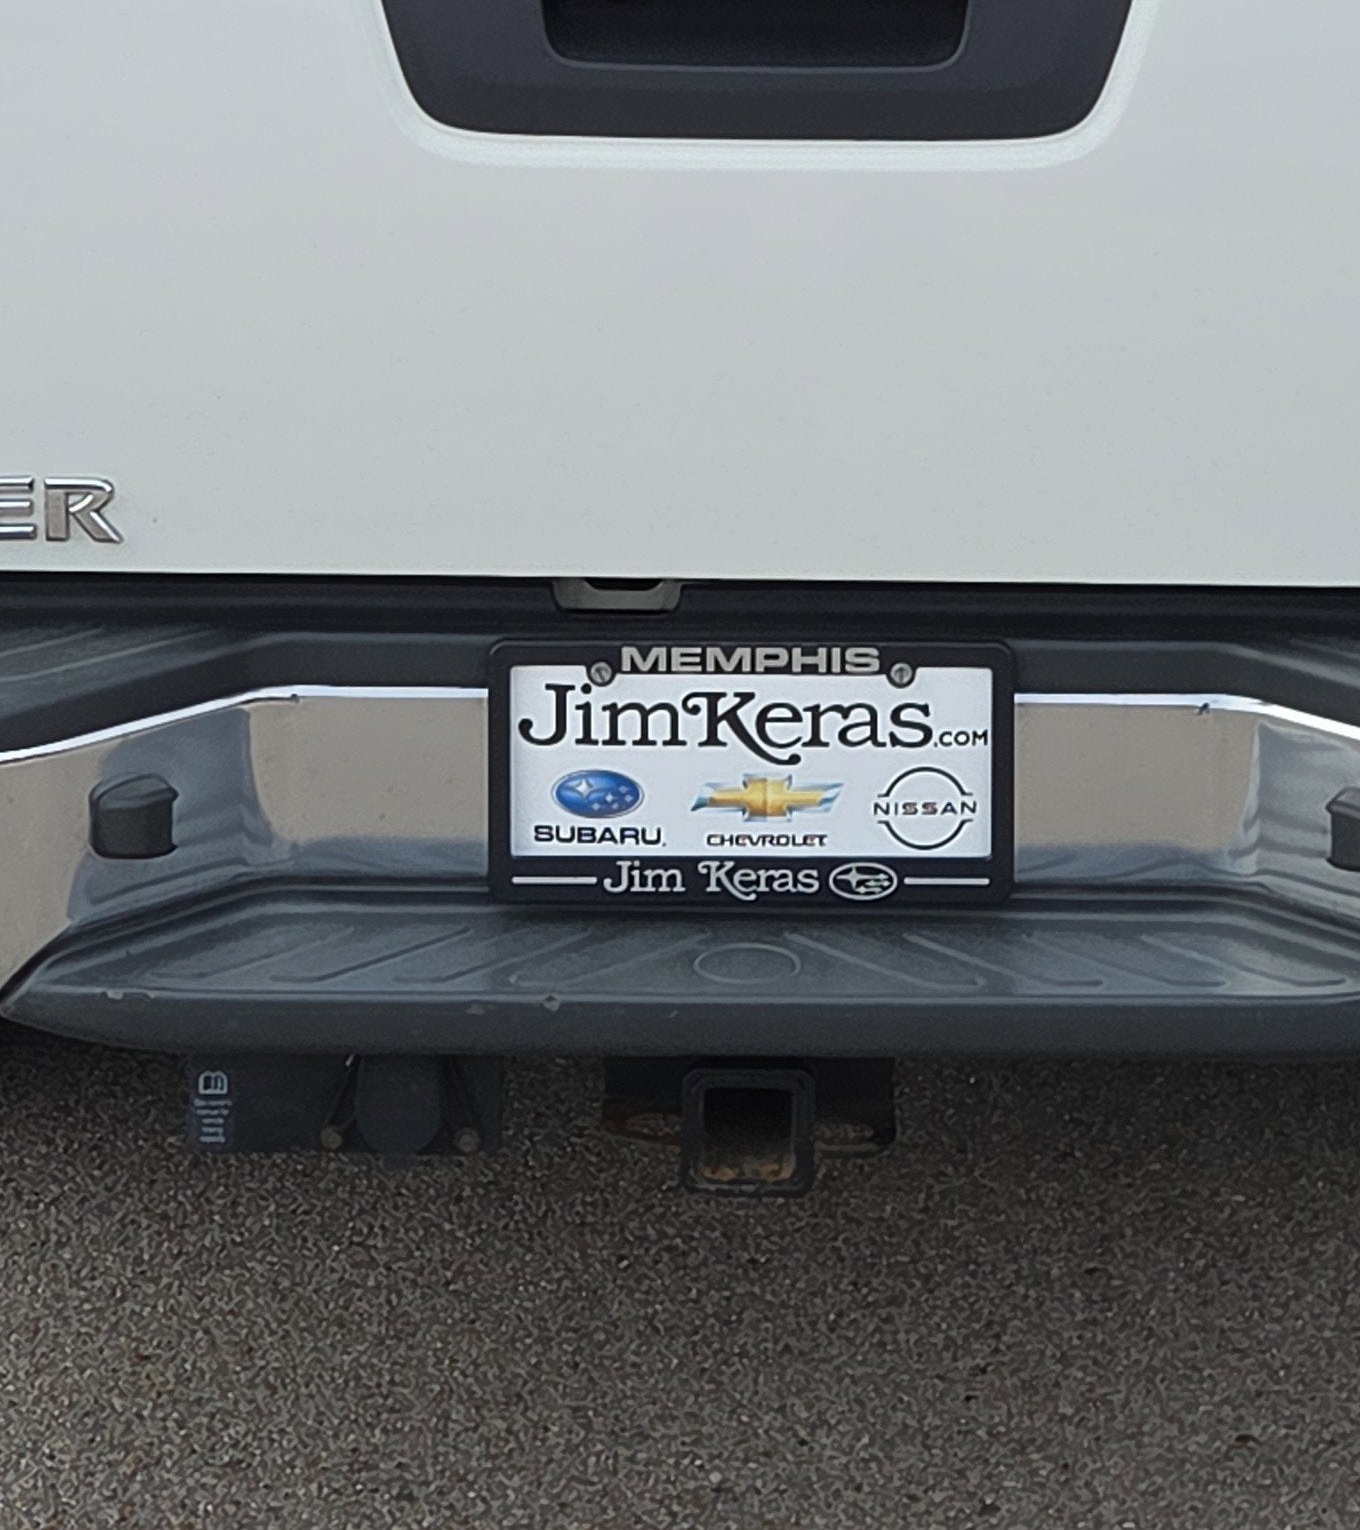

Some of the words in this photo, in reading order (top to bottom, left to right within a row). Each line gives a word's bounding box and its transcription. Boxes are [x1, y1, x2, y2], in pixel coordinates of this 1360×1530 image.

[620, 646, 881, 674] MEMPHIS
[873, 800, 977, 816] NISSAN
[534, 825, 662, 846] SUBARU
[706, 834, 828, 847] CHEVROLET
[603, 860, 686, 893] Jim
[697, 860, 820, 901] Keras
